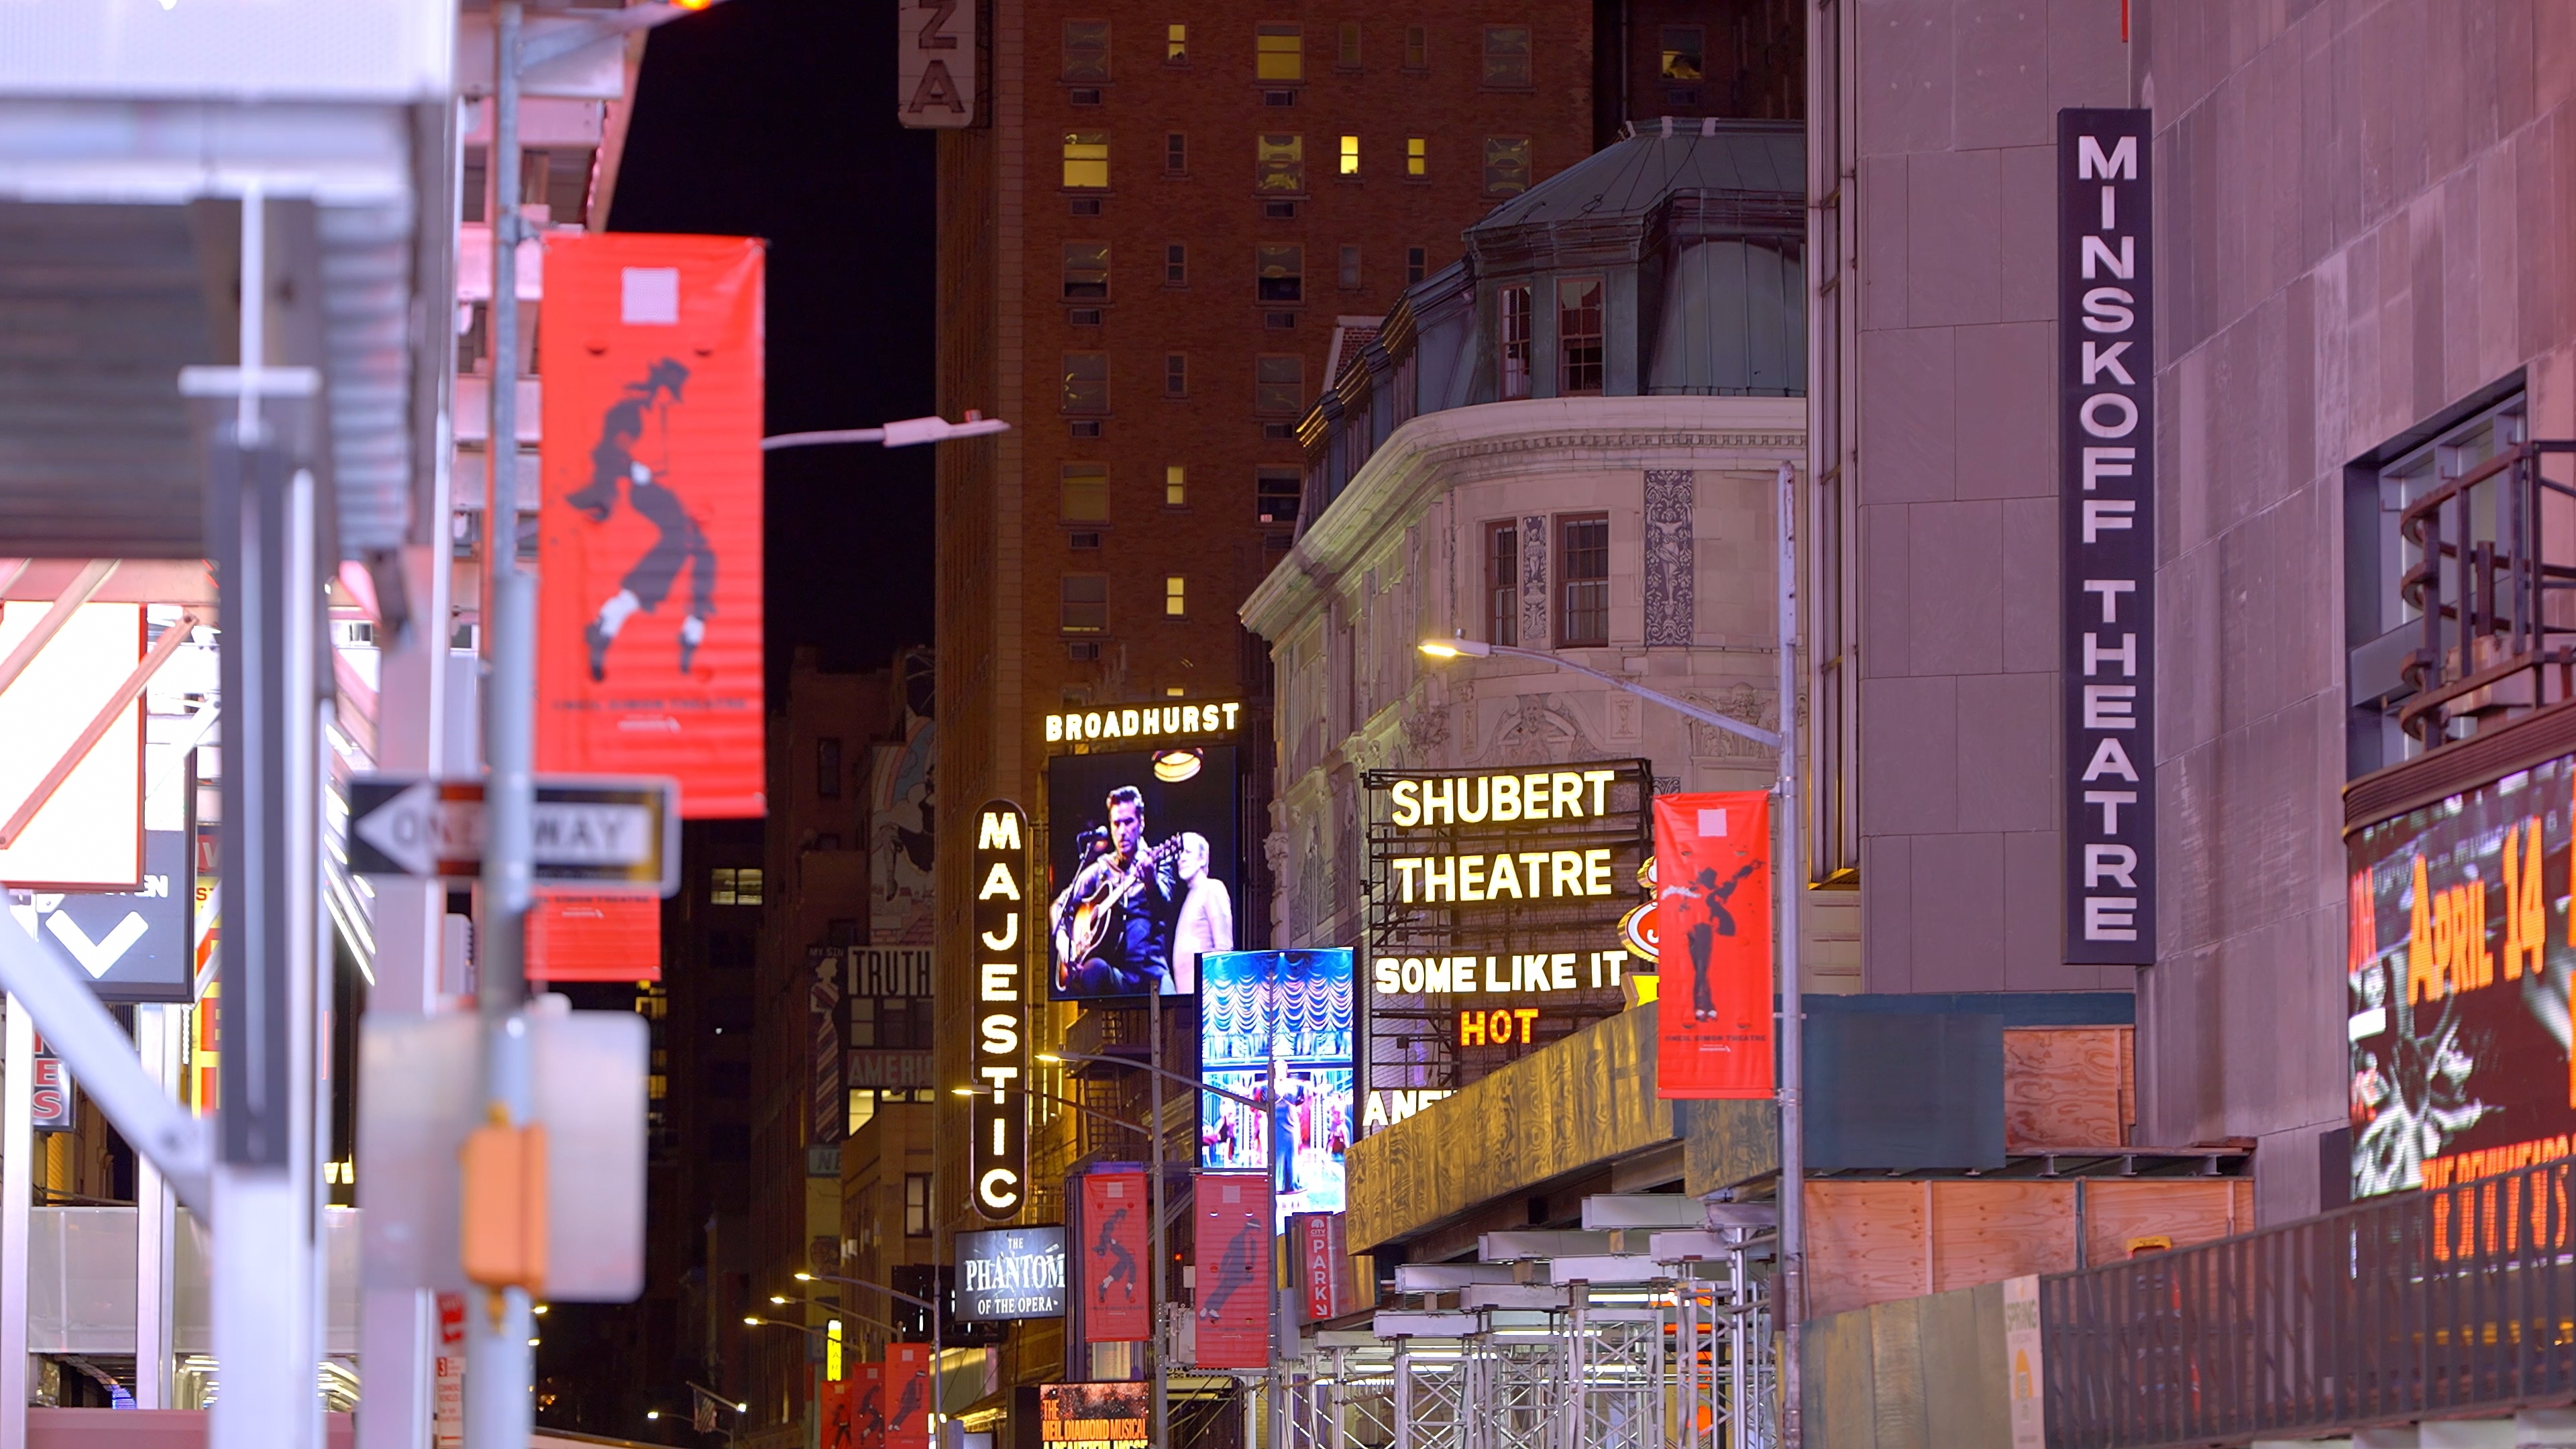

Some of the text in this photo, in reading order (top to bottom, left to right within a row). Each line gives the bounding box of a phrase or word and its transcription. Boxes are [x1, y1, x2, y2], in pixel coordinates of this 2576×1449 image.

[908, 0, 965, 113] ZA
[2079, 136, 2139, 941] MINSKOFF THEATRE
[1046, 702, 1240, 742] BROADHURST
[1391, 770, 1615, 827] SHUBERT
[1392, 849, 1612, 903] THEATRE
[2503, 816, 2546, 982] 14
[852, 950, 931, 996] TRUTH
[1376, 951, 1627, 994] SOME LIKE IT
[979, 812, 1021, 1208] MAJESTIC
[1460, 1008, 1539, 1046] HOT
[1362, 1091, 1389, 1126] A
[1008, 1238, 1024, 1250] THE
[965, 1253, 1065, 1291] PHANTOM
[1313, 1239, 1327, 1301] PARK
[977, 1296, 1053, 1315] OF THE OPERA
[1042, 1399, 1059, 1420] THE
[1042, 1418, 1148, 1441] NEIL DIAMOND MUSICAL
